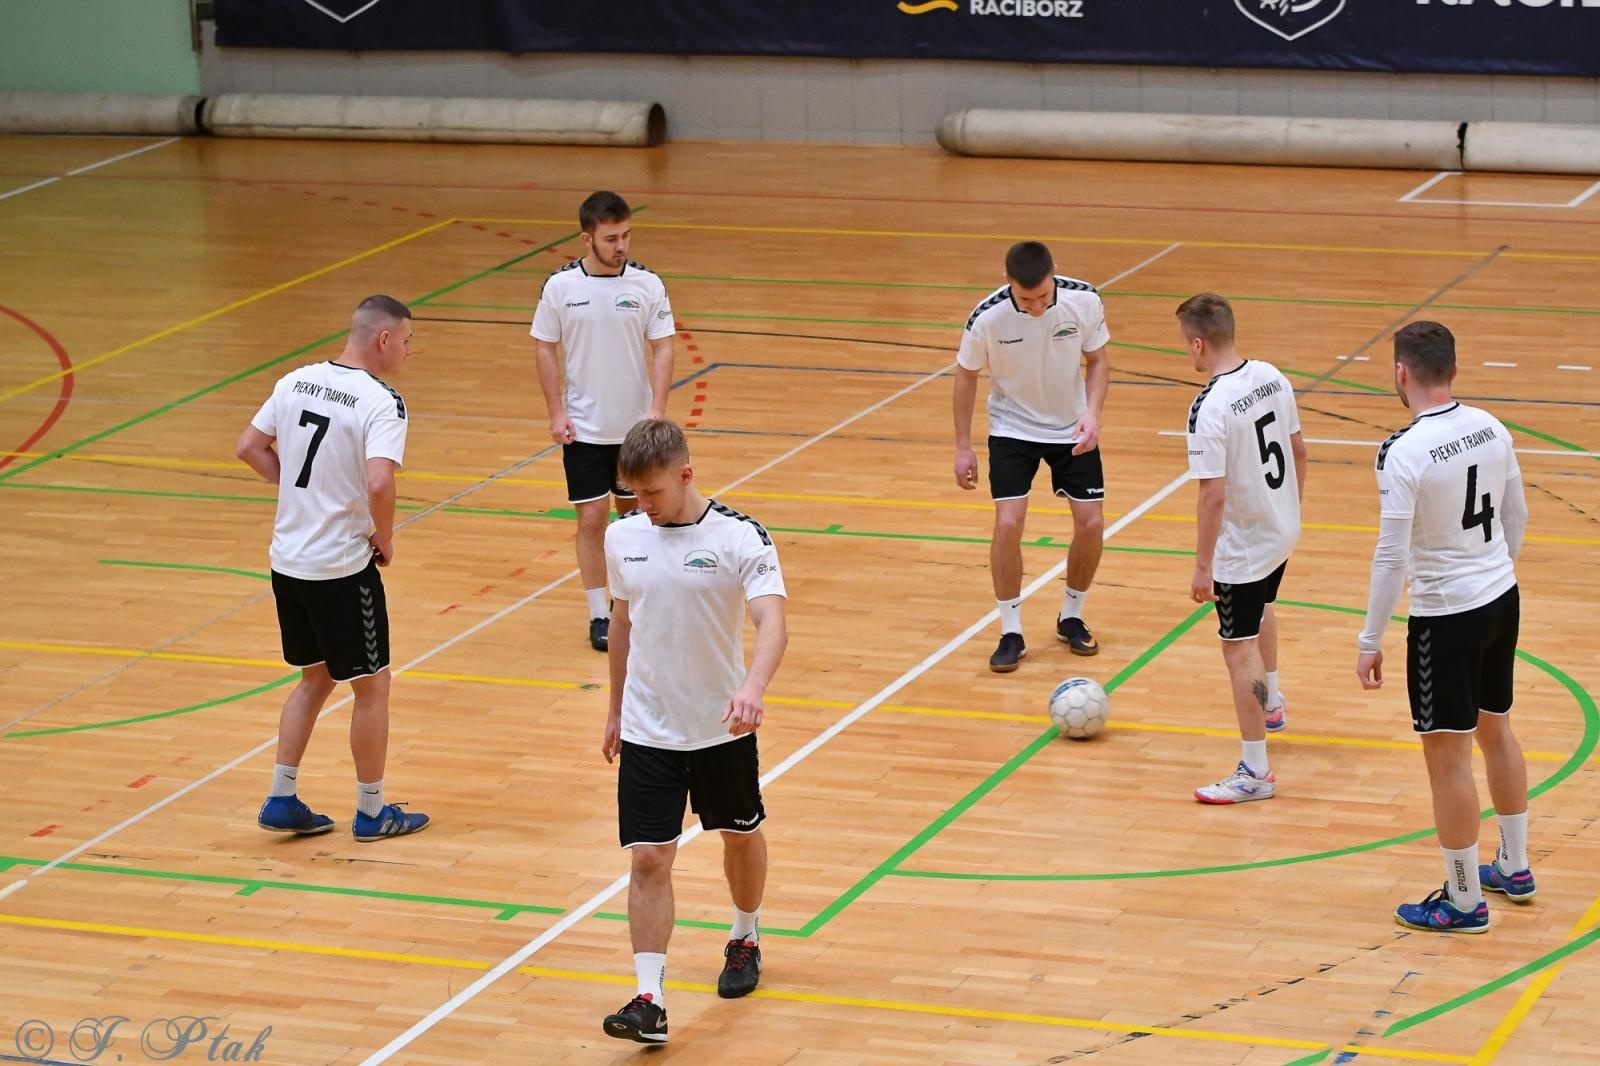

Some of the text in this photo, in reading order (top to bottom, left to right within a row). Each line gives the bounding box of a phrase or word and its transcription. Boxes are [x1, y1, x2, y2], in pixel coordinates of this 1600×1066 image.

[323, 387, 360, 408] TRAWNIK
[295, 409, 331, 489] 7
[1254, 410, 1286, 490] 5
[1429, 426, 1498, 464] PIĘKNY TRAWNIK
[1461, 464, 1495, 543] 4
